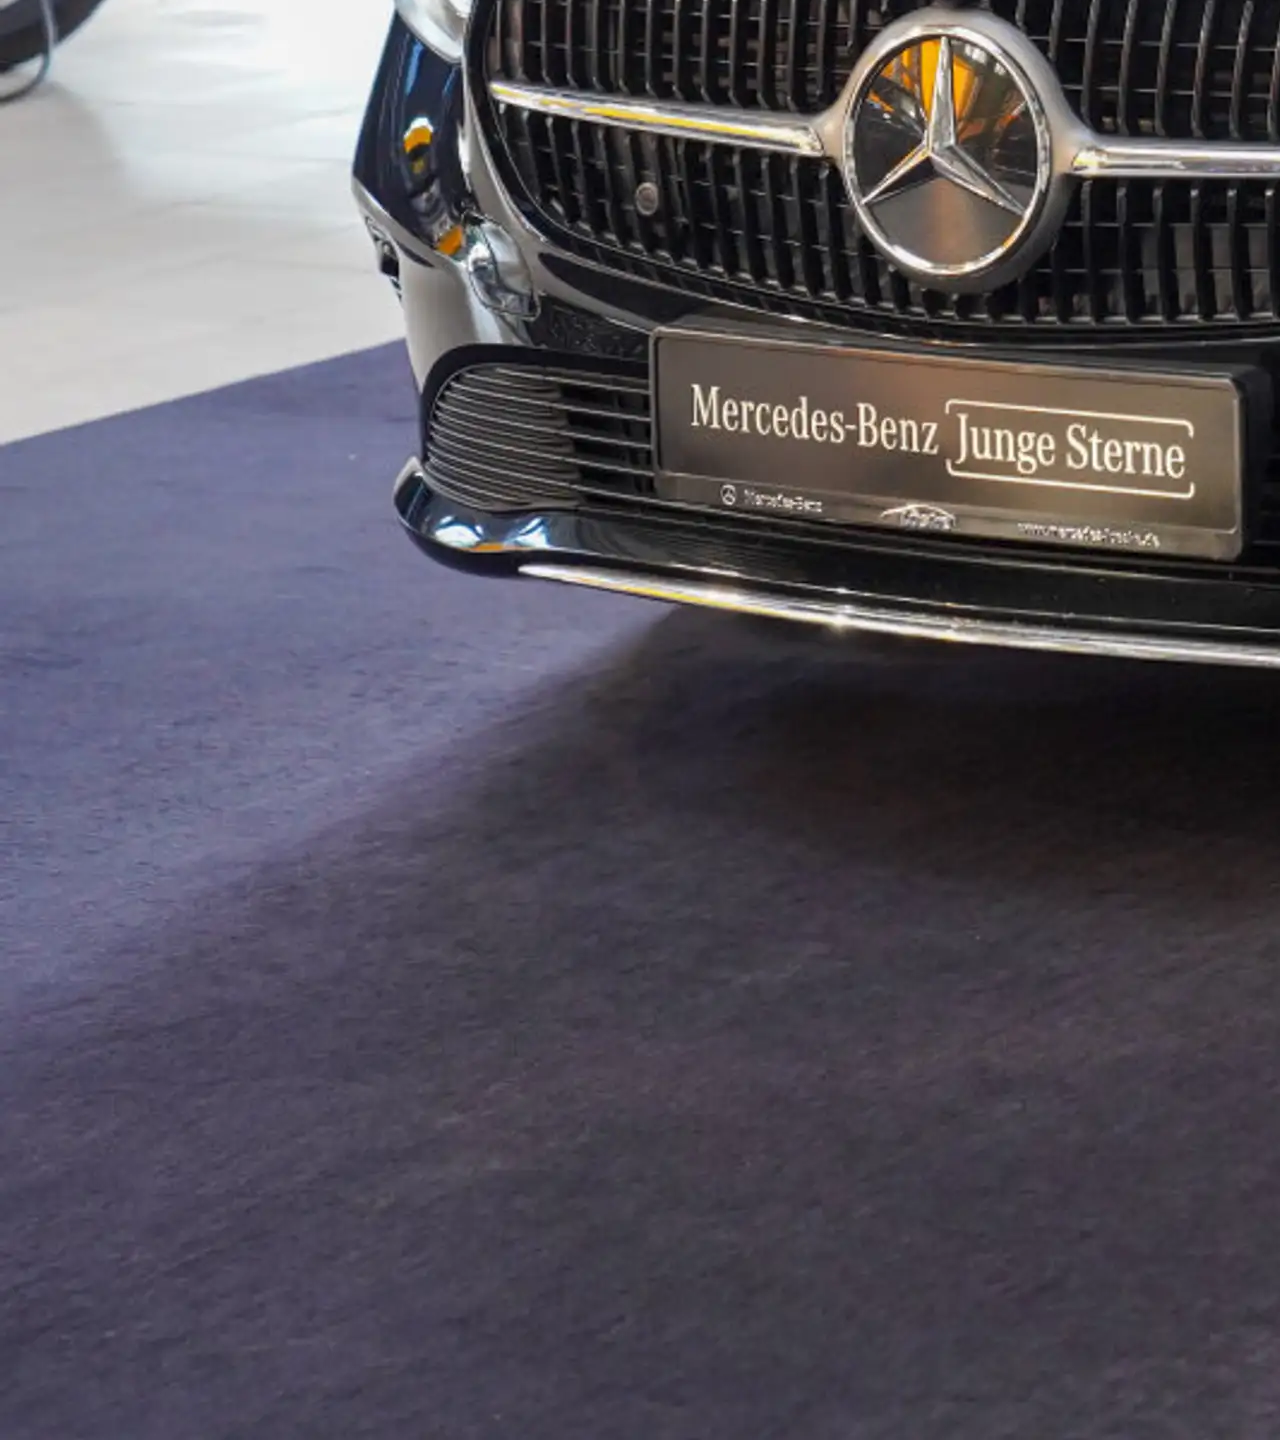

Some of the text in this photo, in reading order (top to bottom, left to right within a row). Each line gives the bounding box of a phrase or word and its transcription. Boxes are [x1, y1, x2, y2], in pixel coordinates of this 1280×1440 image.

[690, 383, 1186, 479] Mercedes-Benz Junge Sterne
